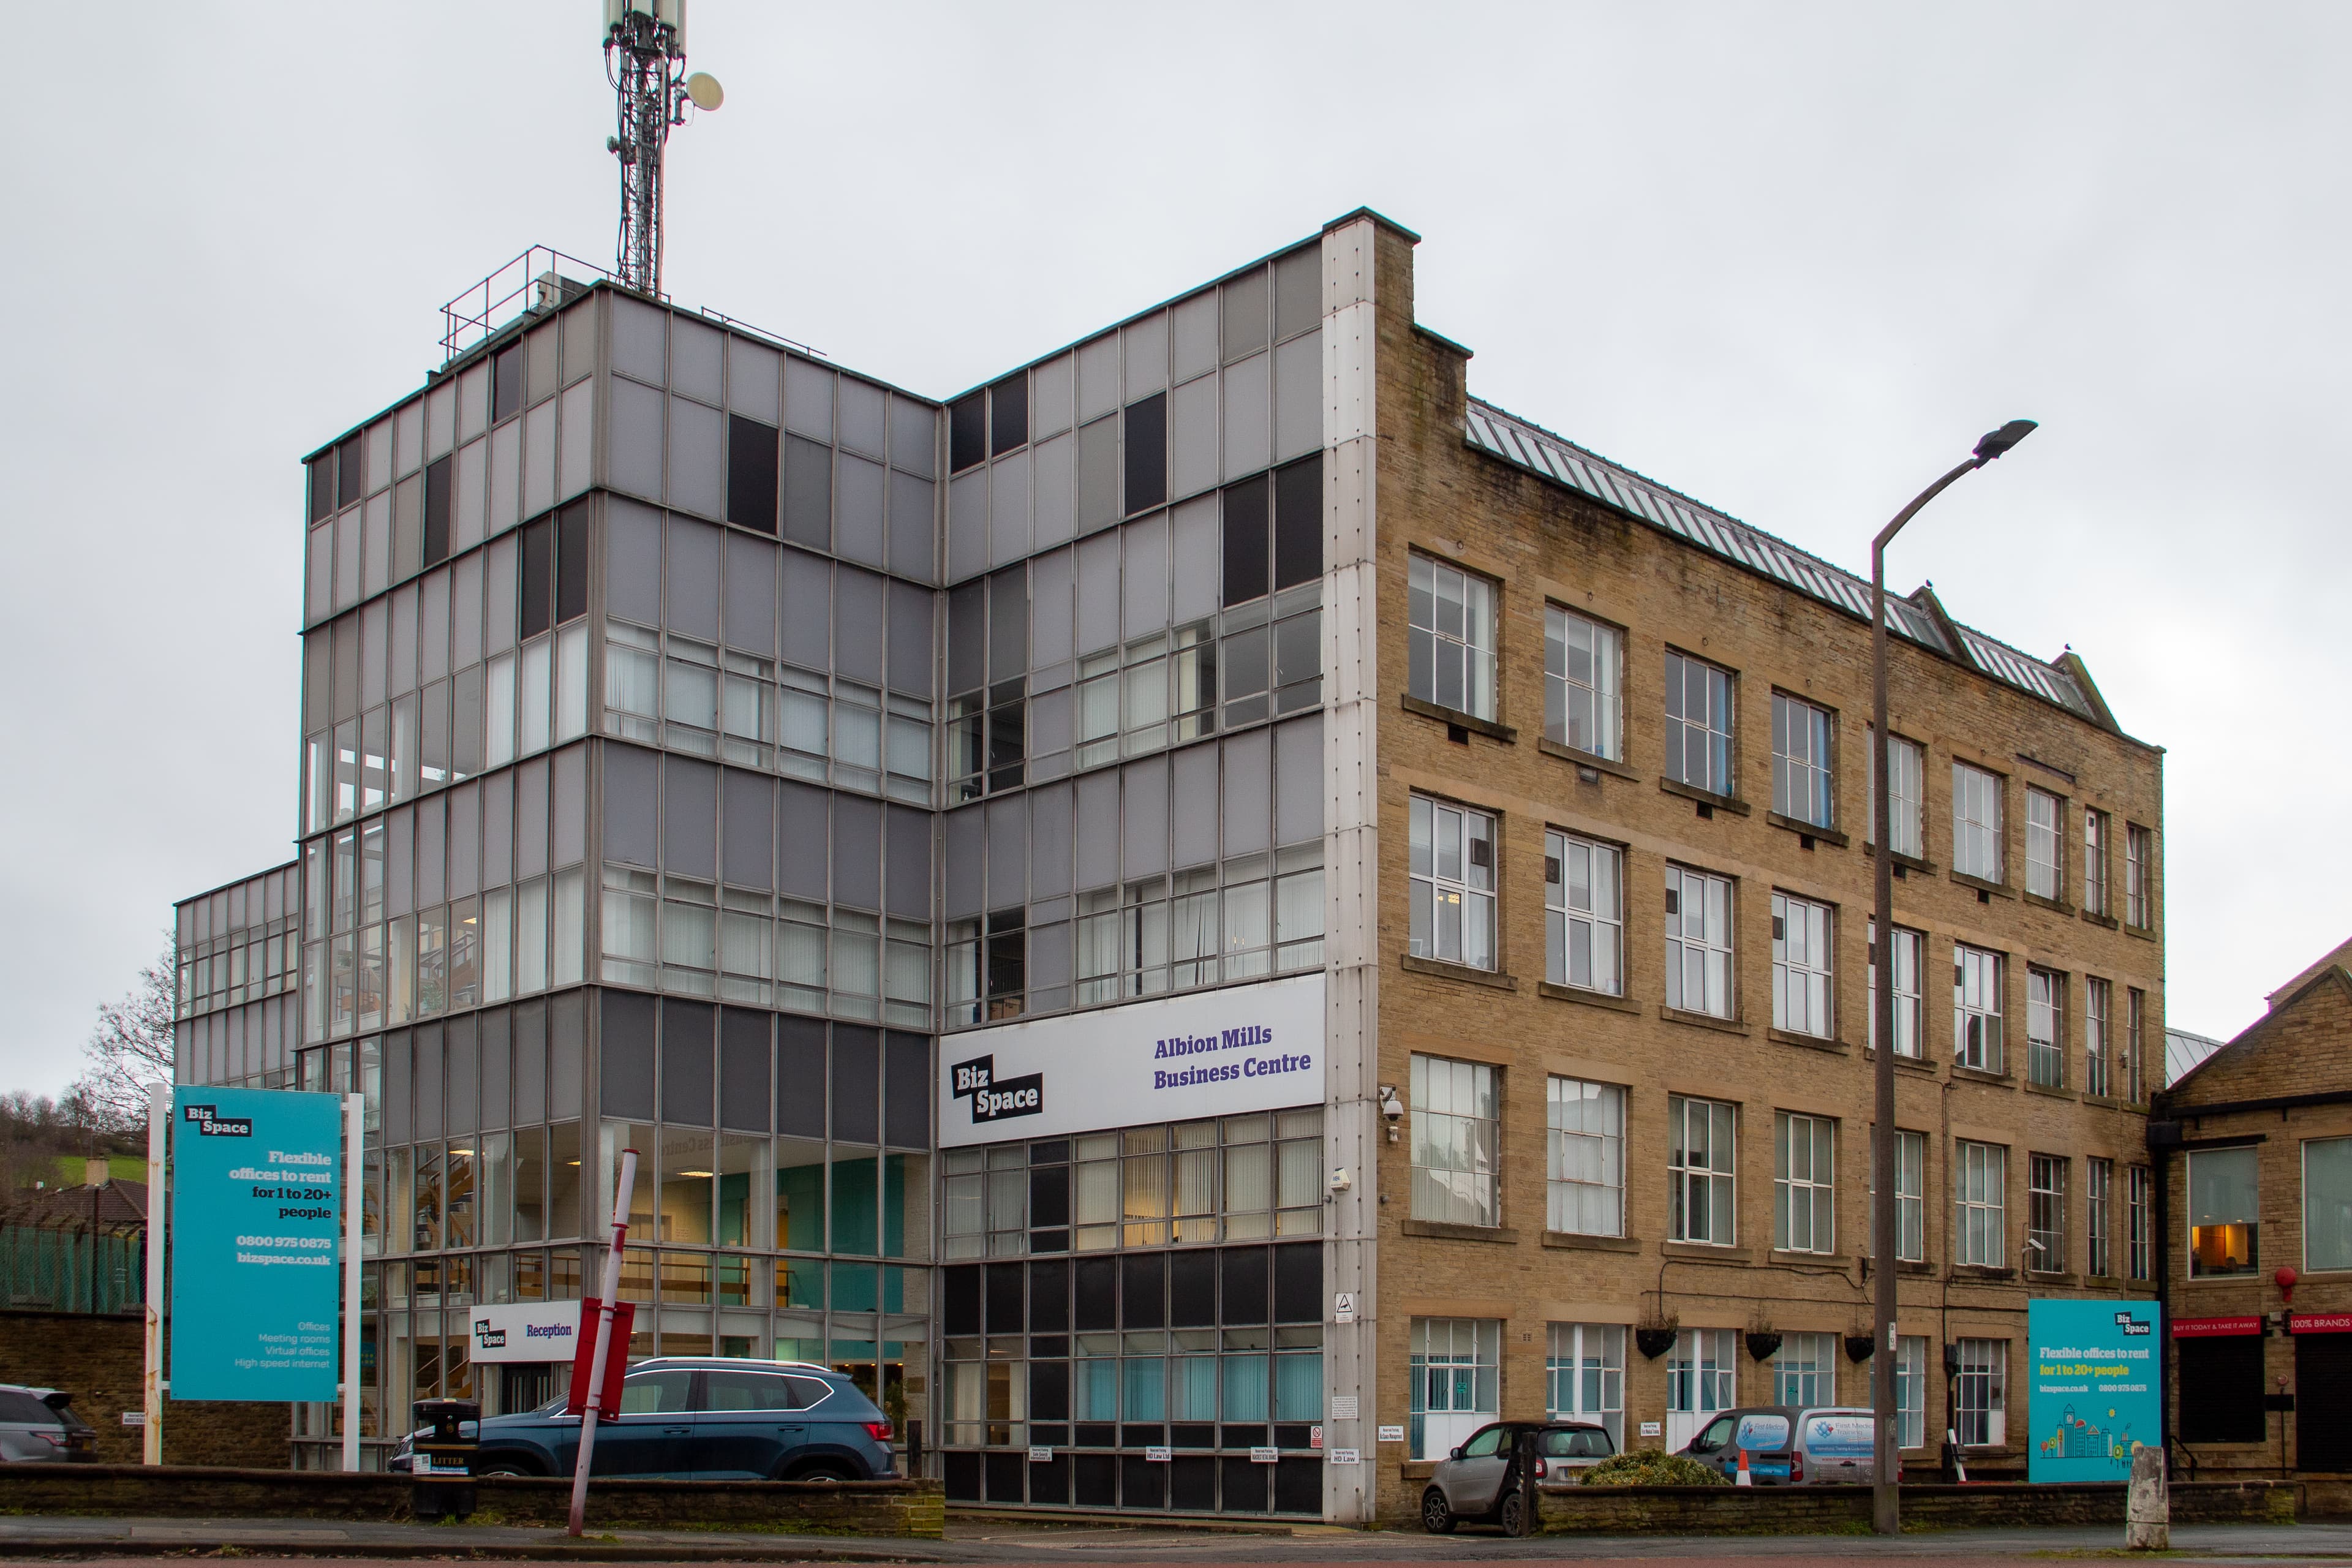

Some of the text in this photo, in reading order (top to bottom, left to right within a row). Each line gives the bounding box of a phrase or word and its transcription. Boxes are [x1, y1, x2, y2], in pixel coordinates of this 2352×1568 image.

[1154, 1025, 1272, 1059] Albion Mills
[957, 1066, 989, 1090] Biz
[1154, 1054, 1311, 1090] Business Centre
[977, 1088, 1038, 1117] Space
[188, 1107, 213, 1120] Biz
[203, 1120, 249, 1134] Space
[268, 1151, 332, 1165] Flexible
[229, 1167, 332, 1183] offices to rent
[252, 1186, 332, 1200] for 1 to 20+
[279, 1207, 332, 1220] people
[236, 1235, 332, 1248] 0800 975 0875
[237, 1252, 331, 1265] bizspace.co.uk
[2117, 1314, 2130, 1323] Biz
[2291, 1318, 2350, 1328] 100% BRANDS
[298, 1322, 331, 1331] Offices
[477, 1323, 489, 1333] Biz
[527, 1322, 572, 1339] Reception
[2125, 1324, 2149, 1334] Space
[258, 1333, 298, 1345] Meeting
[484, 1334, 505, 1346] Space
[265, 1346, 330, 1356] Virtual offices
[2039, 1347, 2149, 1359] Flexible offices to rent
[235, 1358, 330, 1369] High speed internet
[2040, 1364, 2129, 1378] for 1 to 20+ people
[2040, 1385, 2089, 1393] bizspace.co.uk
